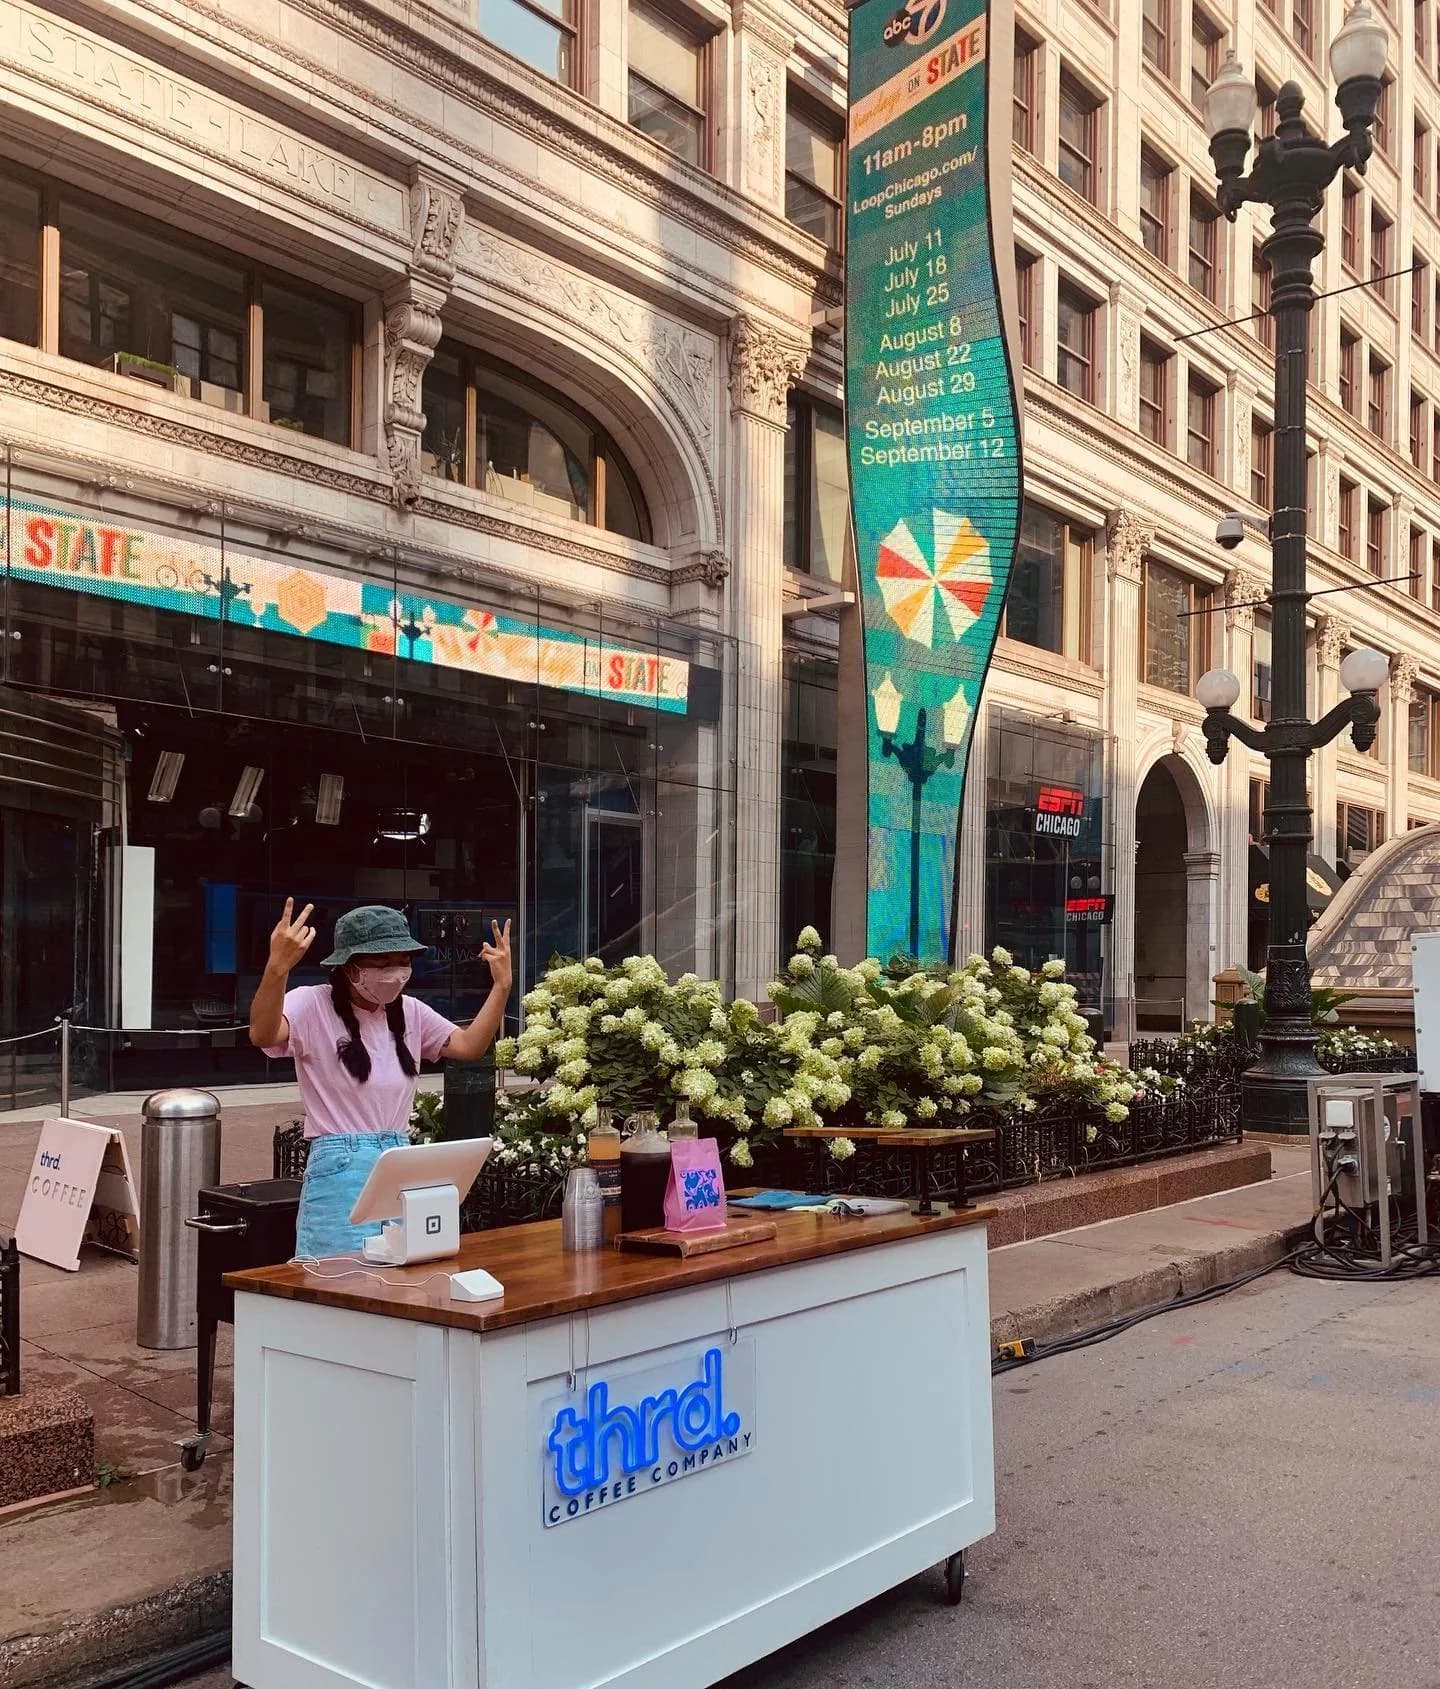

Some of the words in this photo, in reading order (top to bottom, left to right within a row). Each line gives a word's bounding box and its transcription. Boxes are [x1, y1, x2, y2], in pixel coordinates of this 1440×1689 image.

[906, 74, 921, 93] ON
[926, 27, 981, 85] STATE
[27, 21, 194, 130] STATE
[239, 117, 353, 204] LAKE
[863, 112, 968, 176] 11am-8pm
[853, 145, 979, 215] LoopChicago.com/
[884, 185, 943, 220] Sundays
[884, 239, 919, 267] July
[924, 228, 942, 249] 11
[884, 266, 920, 293] July
[925, 255, 948, 278] 18
[885, 292, 921, 318] July
[926, 282, 951, 307] 25
[879, 320, 945, 353] August
[949, 315, 962, 338] 8
[875, 349, 942, 380] August
[946, 343, 972, 365] 22
[876, 376, 945, 407] August
[949, 370, 977, 394] 29
[864, 409, 975, 441] September
[981, 406, 995, 429] 5
[860, 440, 972, 468] September
[979, 438, 1005, 459] 12
[23, 516, 146, 581] STATE
[607, 653, 672, 695] STATE
[1037, 786, 1085, 816] ESPN
[1035, 813, 1081, 837] CHICAGO
[1066, 898, 1106, 912] ESPN
[1066, 911, 1105, 922] CHICAGO
[40, 1151, 61, 1171] thrd.
[31, 1175, 87, 1209] COFFEE
[547, 1347, 741, 1496] thrd.
[549, 1476, 637, 1523] COFFEE
[652, 1431, 752, 1483] COMPANY
